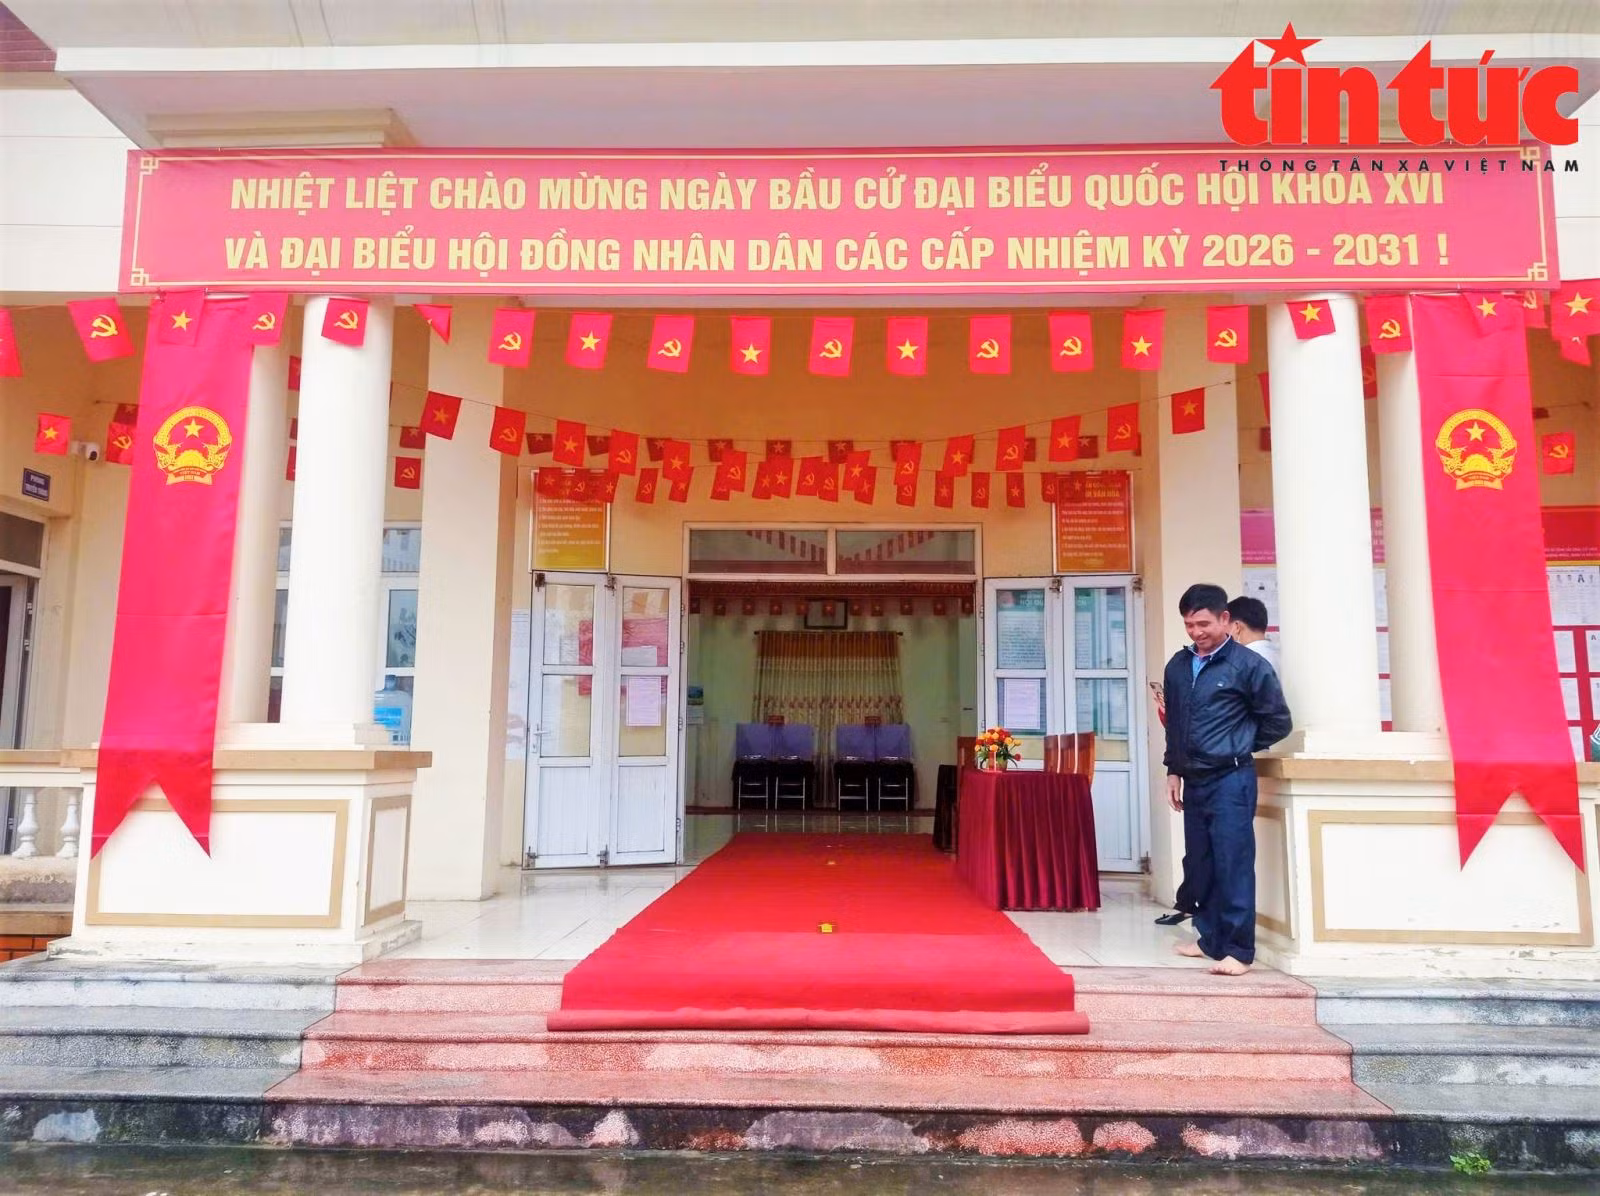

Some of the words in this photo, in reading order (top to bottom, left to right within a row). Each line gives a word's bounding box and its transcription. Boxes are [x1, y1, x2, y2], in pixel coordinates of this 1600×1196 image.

[230, 171, 336, 217] NHIỆT
[345, 170, 419, 216] LIỆT
[429, 171, 527, 211] CHÀO
[538, 171, 648, 211] MỪNG
[659, 171, 757, 211] NGÀY
[769, 167, 842, 211] BẦU
[854, 166, 907, 210] CỬ
[913, 176, 975, 216] ĐẠI
[988, 162, 1072, 209] BIỂU
[1084, 162, 1185, 211] QUỐC
[1197, 165, 1259, 212] HỘI
[1271, 166, 1373, 205] KHÓA
[1383, 172, 1445, 205] XVI
[224, 230, 269, 270] VÀ
[279, 236, 342, 276] ĐẠI
[352, 224, 437, 271] BIỂU
[447, 231, 509, 277] HỘI
[519, 227, 621, 272] ĐỒNG
[633, 232, 735, 272] NHÂN
[747, 232, 823, 272] DÂN
[835, 231, 908, 272] CÁC
[921, 225, 995, 271] CẤP
[1007, 229, 1130, 276] NHIỆM
[1142, 227, 1192, 269] KỲ
[1202, 233, 1294, 268] 2026
[1306, 248, 1321, 256] -
[1333, 233, 1419, 267] 2031
[1437, 233, 1449, 267] !
